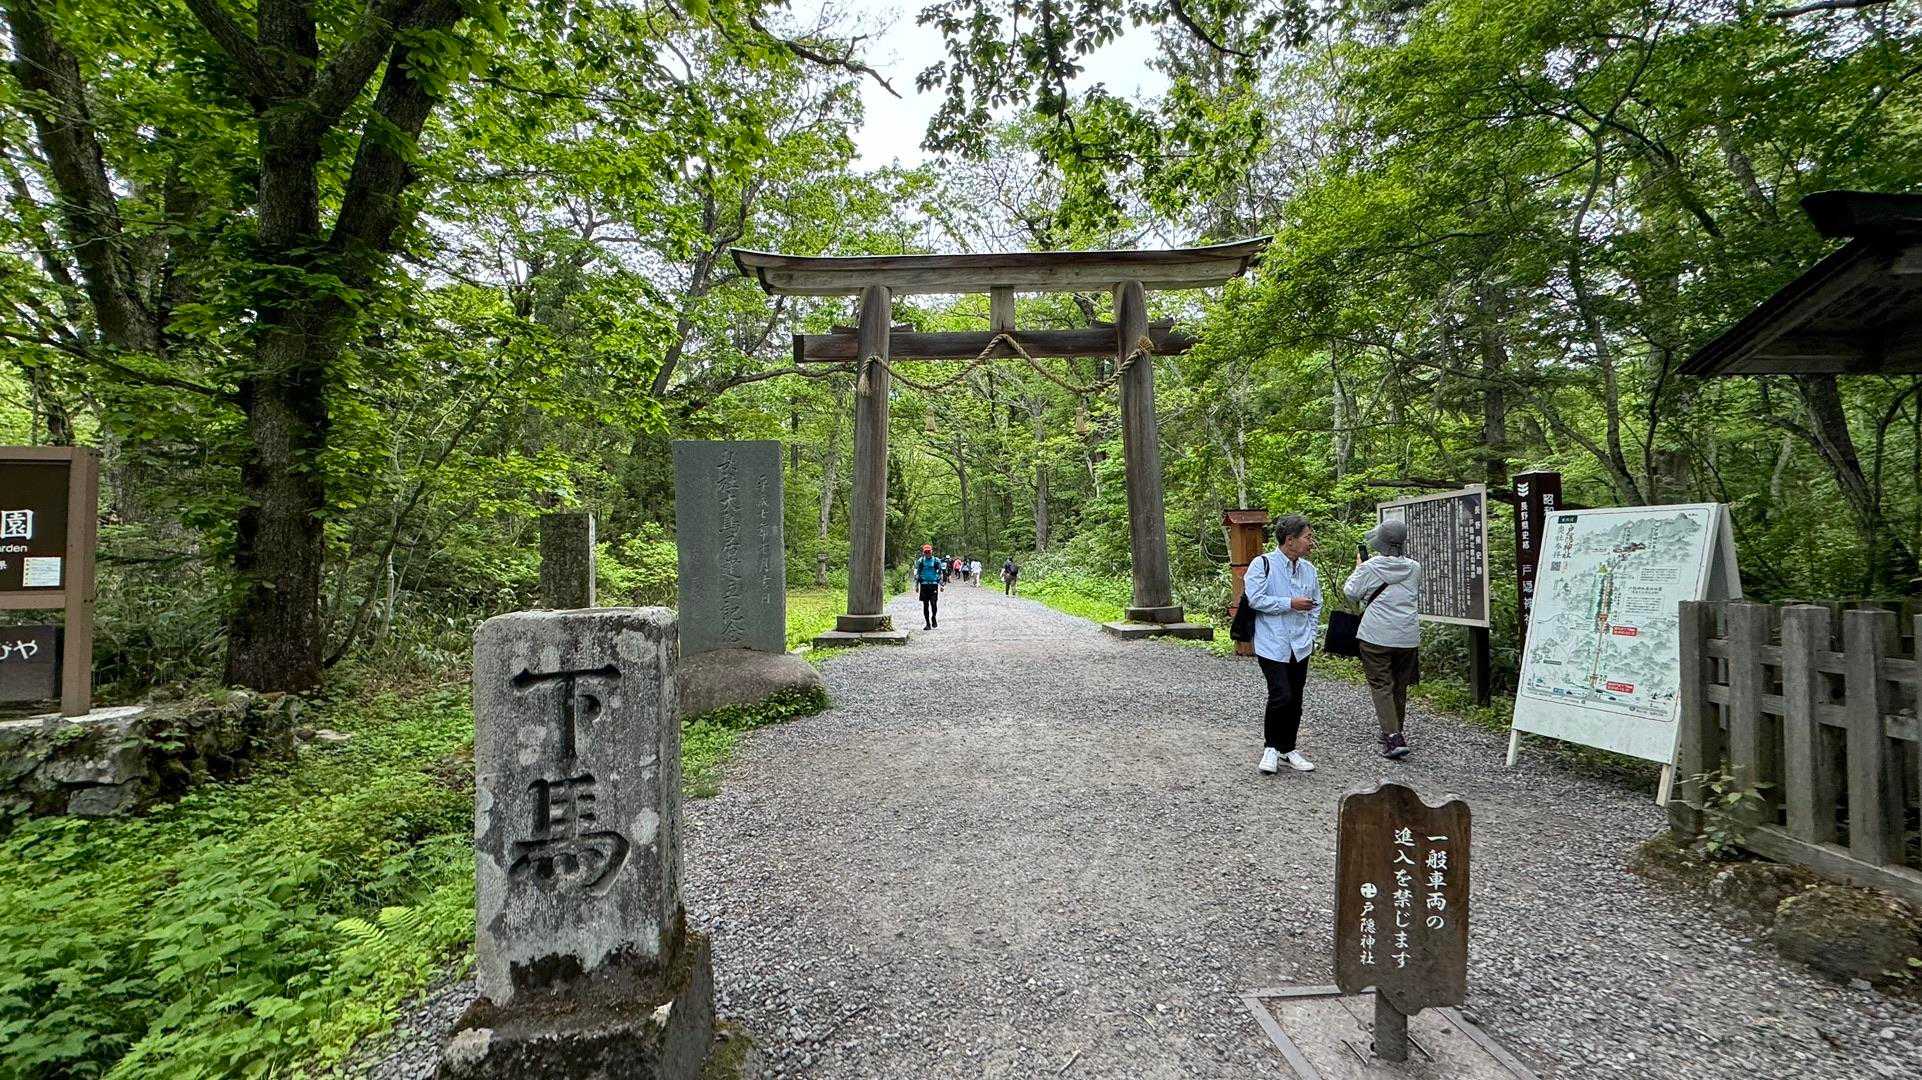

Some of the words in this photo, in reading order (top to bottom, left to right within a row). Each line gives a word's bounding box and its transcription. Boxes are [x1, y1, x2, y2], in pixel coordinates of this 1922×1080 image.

[0, 509, 33, 541] 園
[509, 664, 631, 896] 下馬
[1391, 826, 1416, 969] 進入を禁じます
[1425, 834, 1448, 930] 一般車両の
[1359, 901, 1377, 966] 戸隠神社
